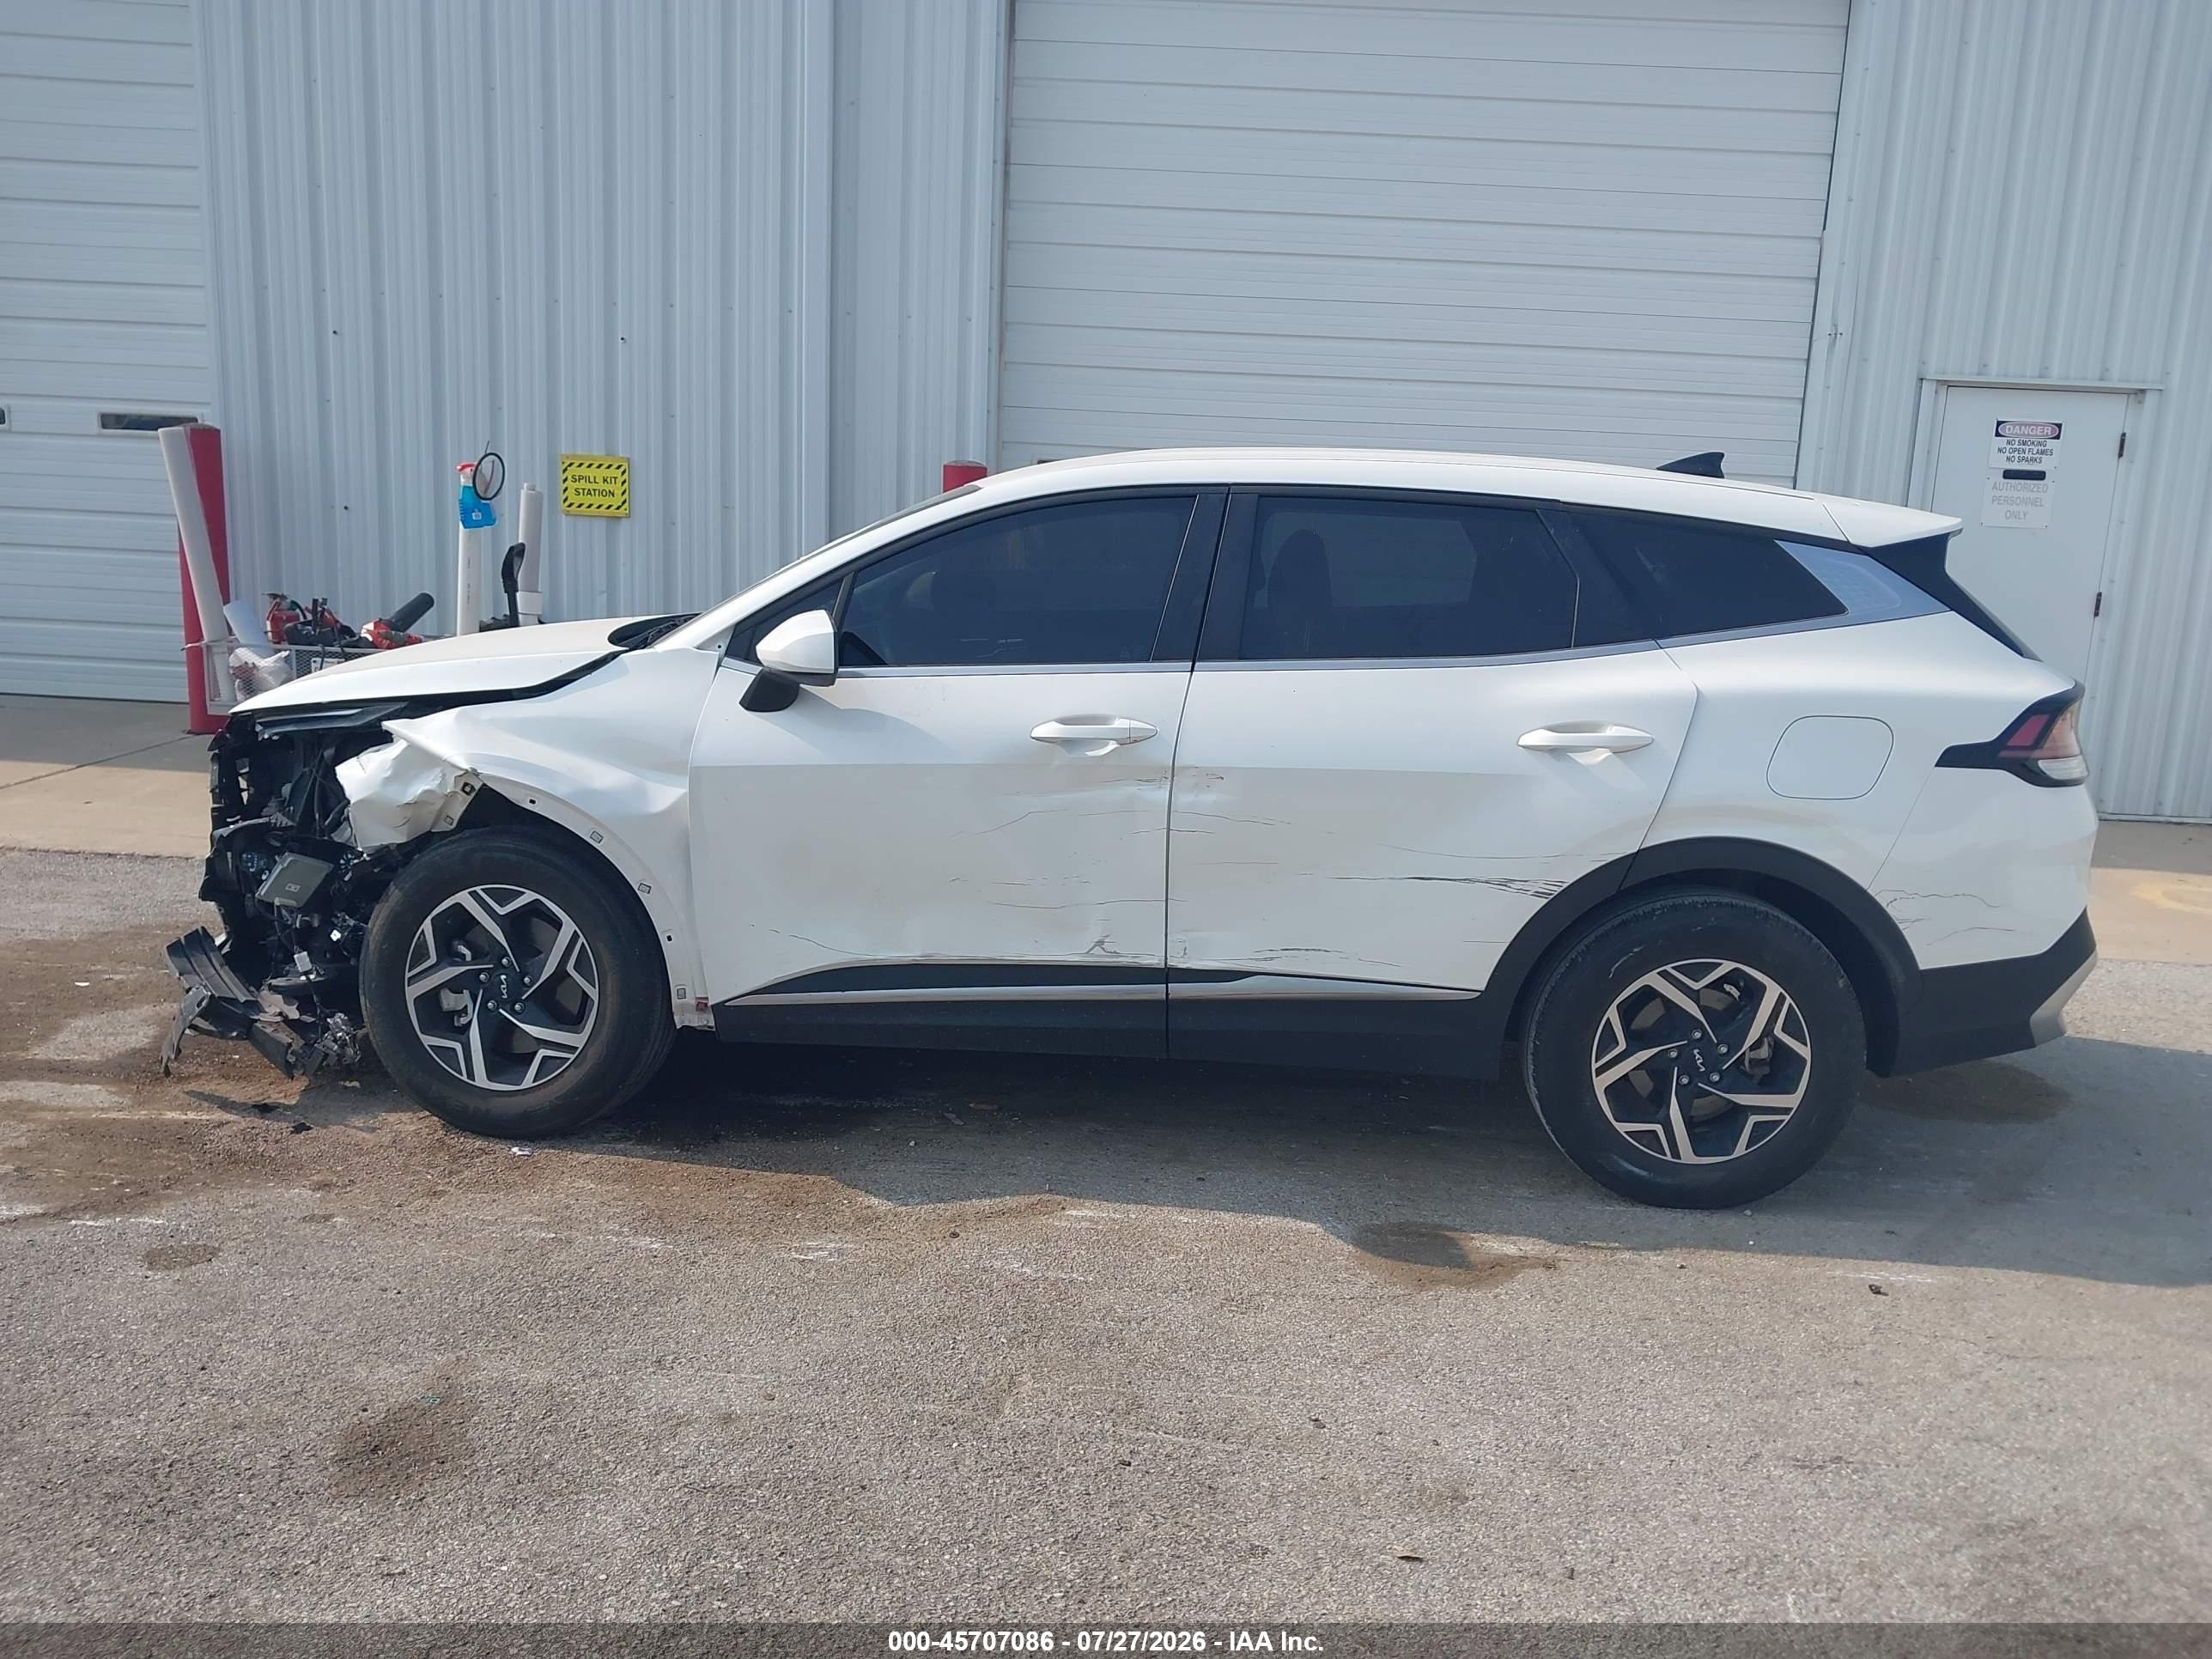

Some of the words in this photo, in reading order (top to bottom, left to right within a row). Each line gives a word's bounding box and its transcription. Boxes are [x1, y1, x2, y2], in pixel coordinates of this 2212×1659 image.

[2005, 424, 2052, 436] DANGER
[2017, 439, 2047, 447] SMOKING
[2016, 455, 2043, 464] SPARKS
[571, 474, 599, 484] SPILL
[602, 475, 618, 485] KIT
[574, 487, 616, 498] STATION
[1991, 482, 2049, 494] AUTHORIZED
[1991, 495, 2045, 507] PERSONNEL
[2004, 510, 2028, 520] ONLY
